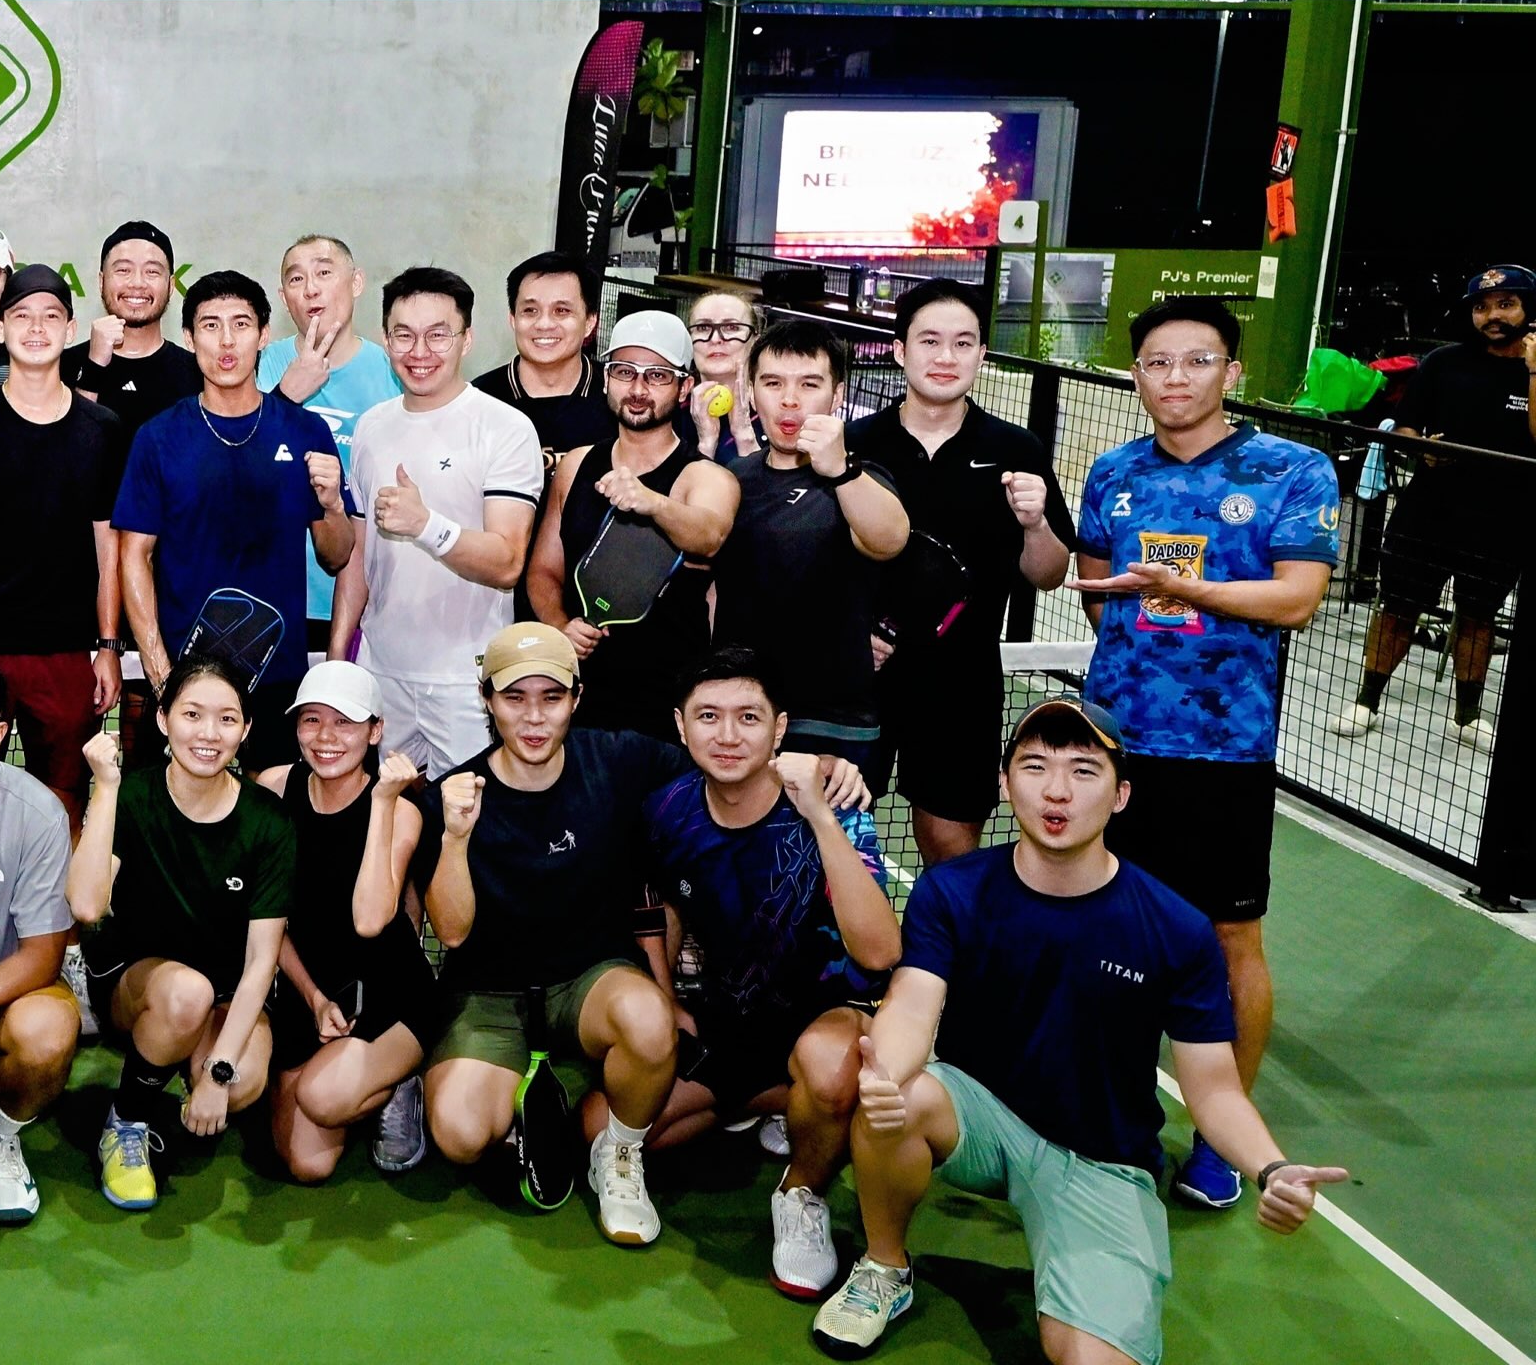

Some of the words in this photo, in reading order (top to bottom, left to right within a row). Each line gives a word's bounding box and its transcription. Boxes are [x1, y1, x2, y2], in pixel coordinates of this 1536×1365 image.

[1014, 214, 1025, 230] 4
[1160, 270, 1191, 283] PJ's
[1196, 271, 1254, 284] Premier
[1146, 542, 1201, 562] DADBOD
[1101, 959, 1145, 984] TITAN
